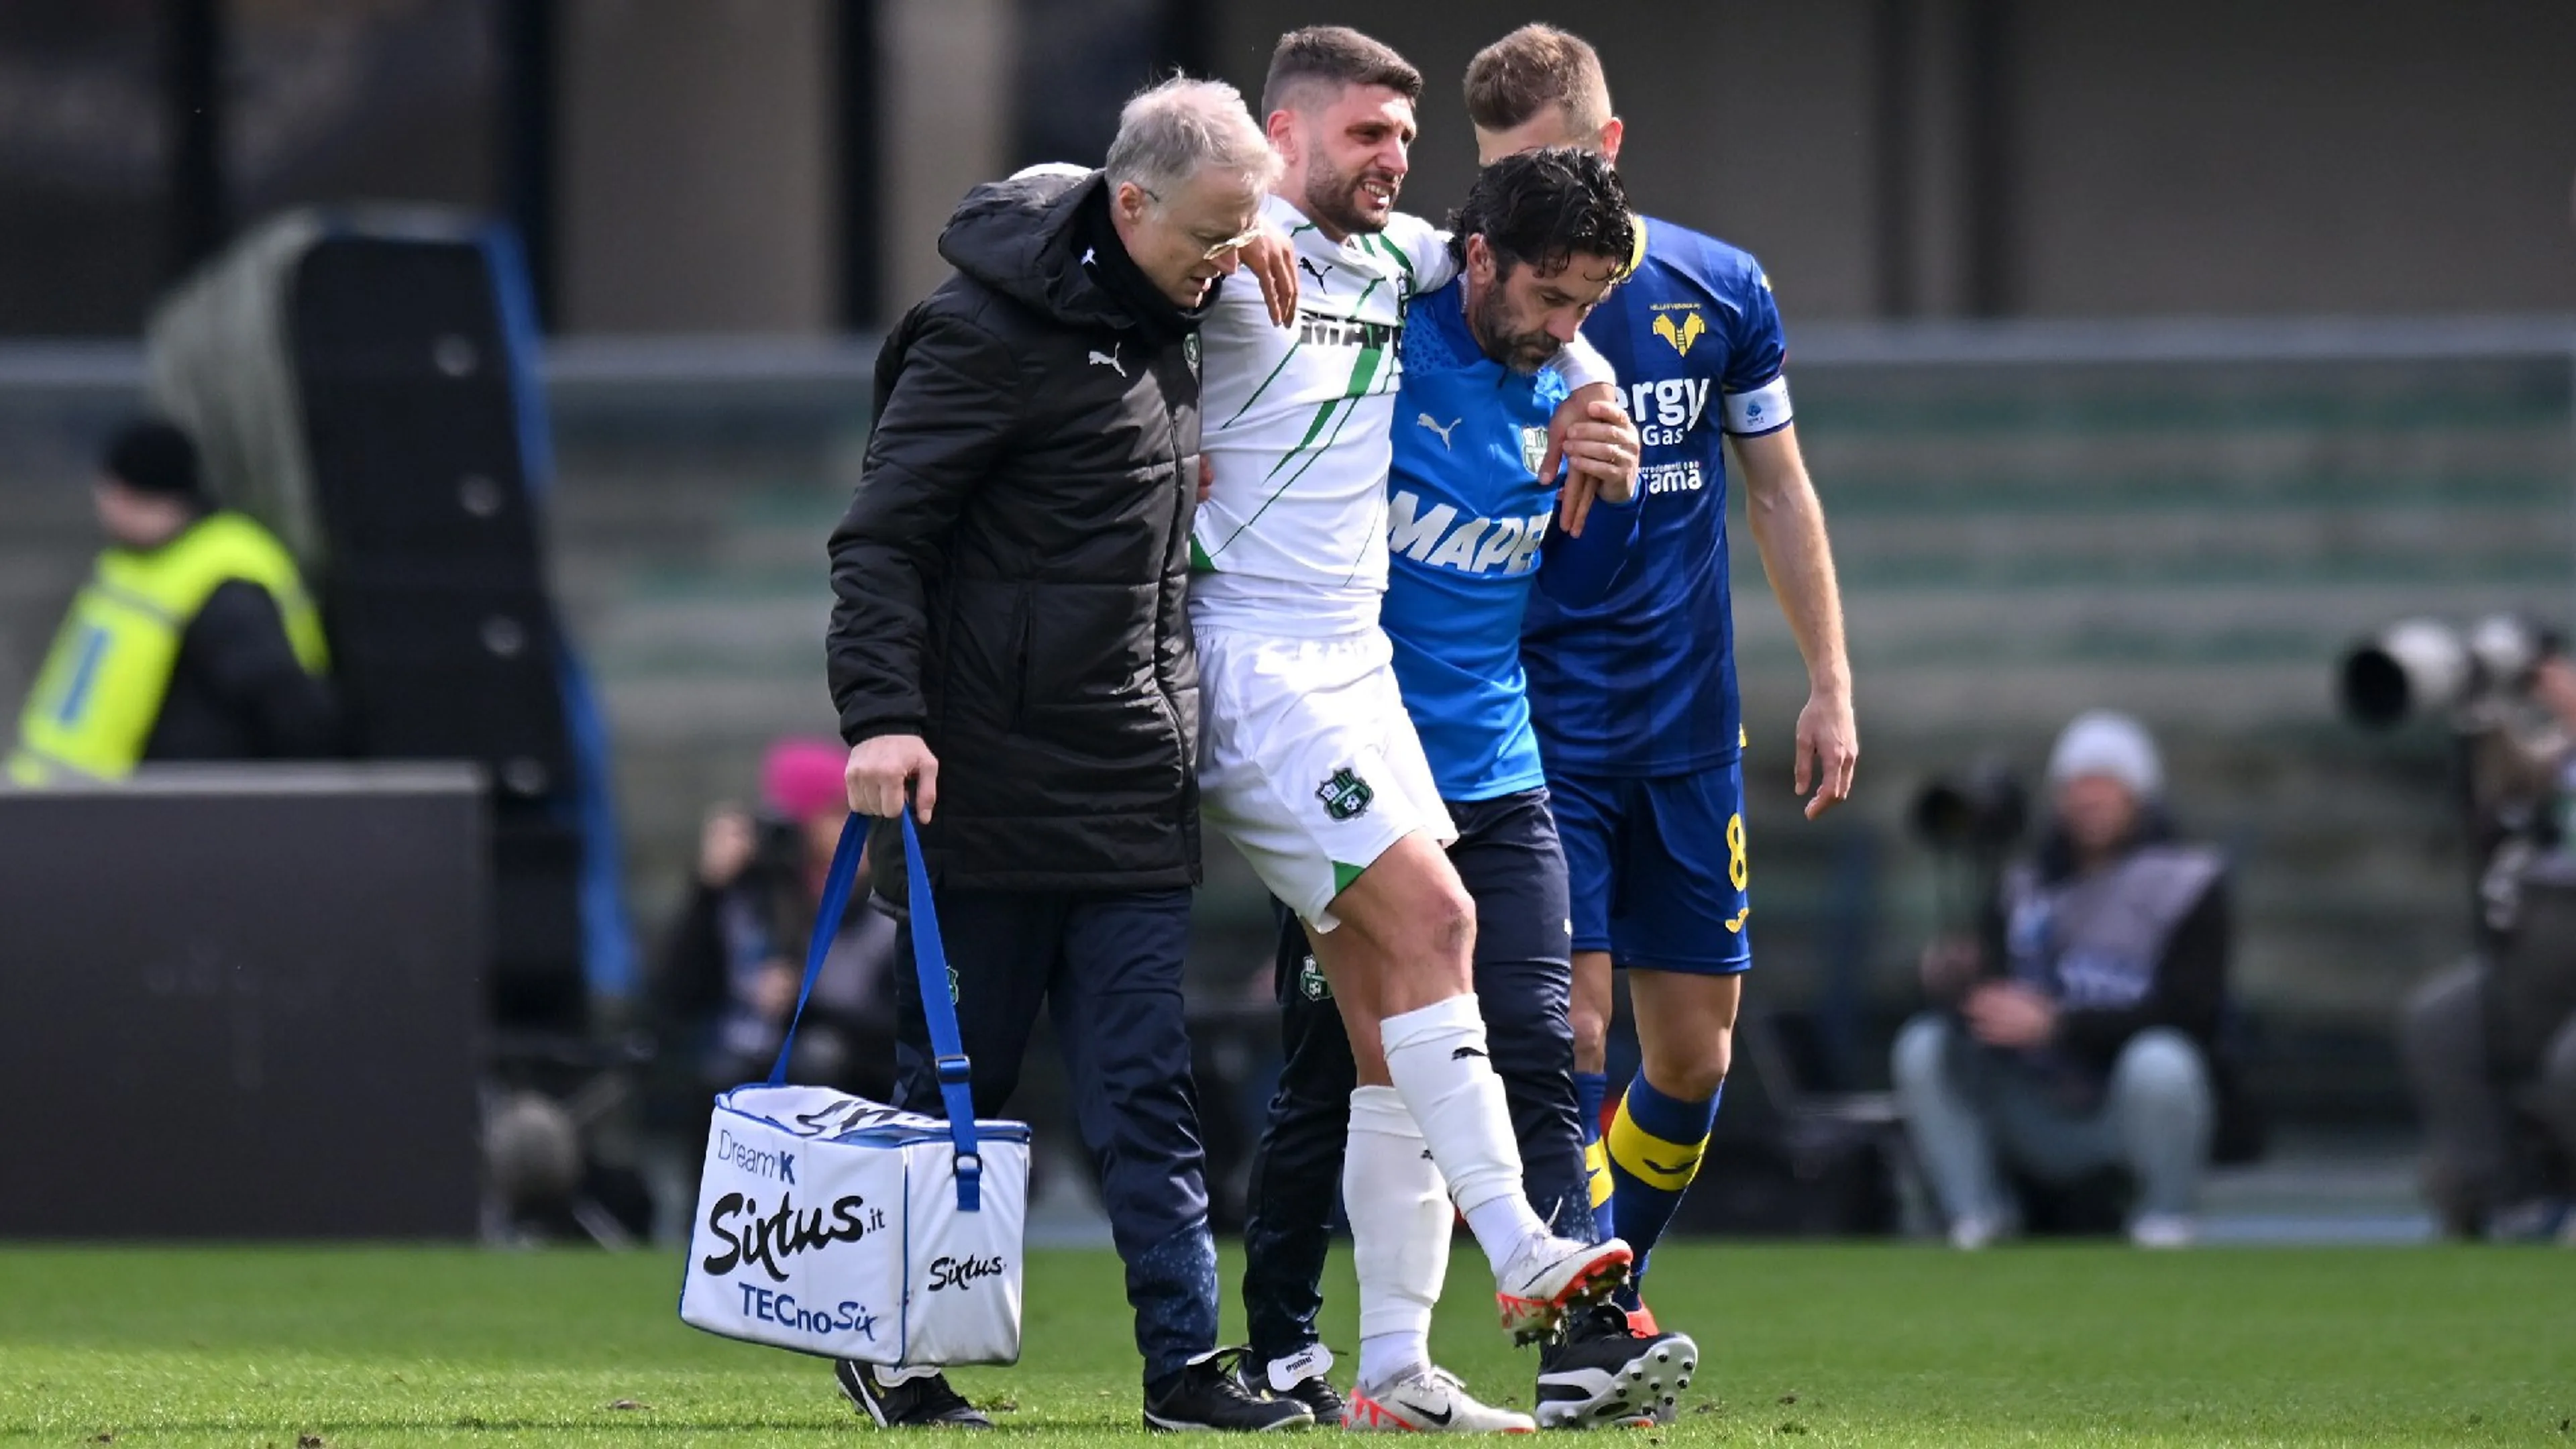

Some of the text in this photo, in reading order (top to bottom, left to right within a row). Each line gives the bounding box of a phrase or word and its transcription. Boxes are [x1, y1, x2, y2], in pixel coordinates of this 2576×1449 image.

[1642, 425, 1684, 446] Gas
[1642, 469, 1702, 494] ama
[1727, 812, 1747, 892] 8
[928, 1253, 1002, 1291] Sixtus
